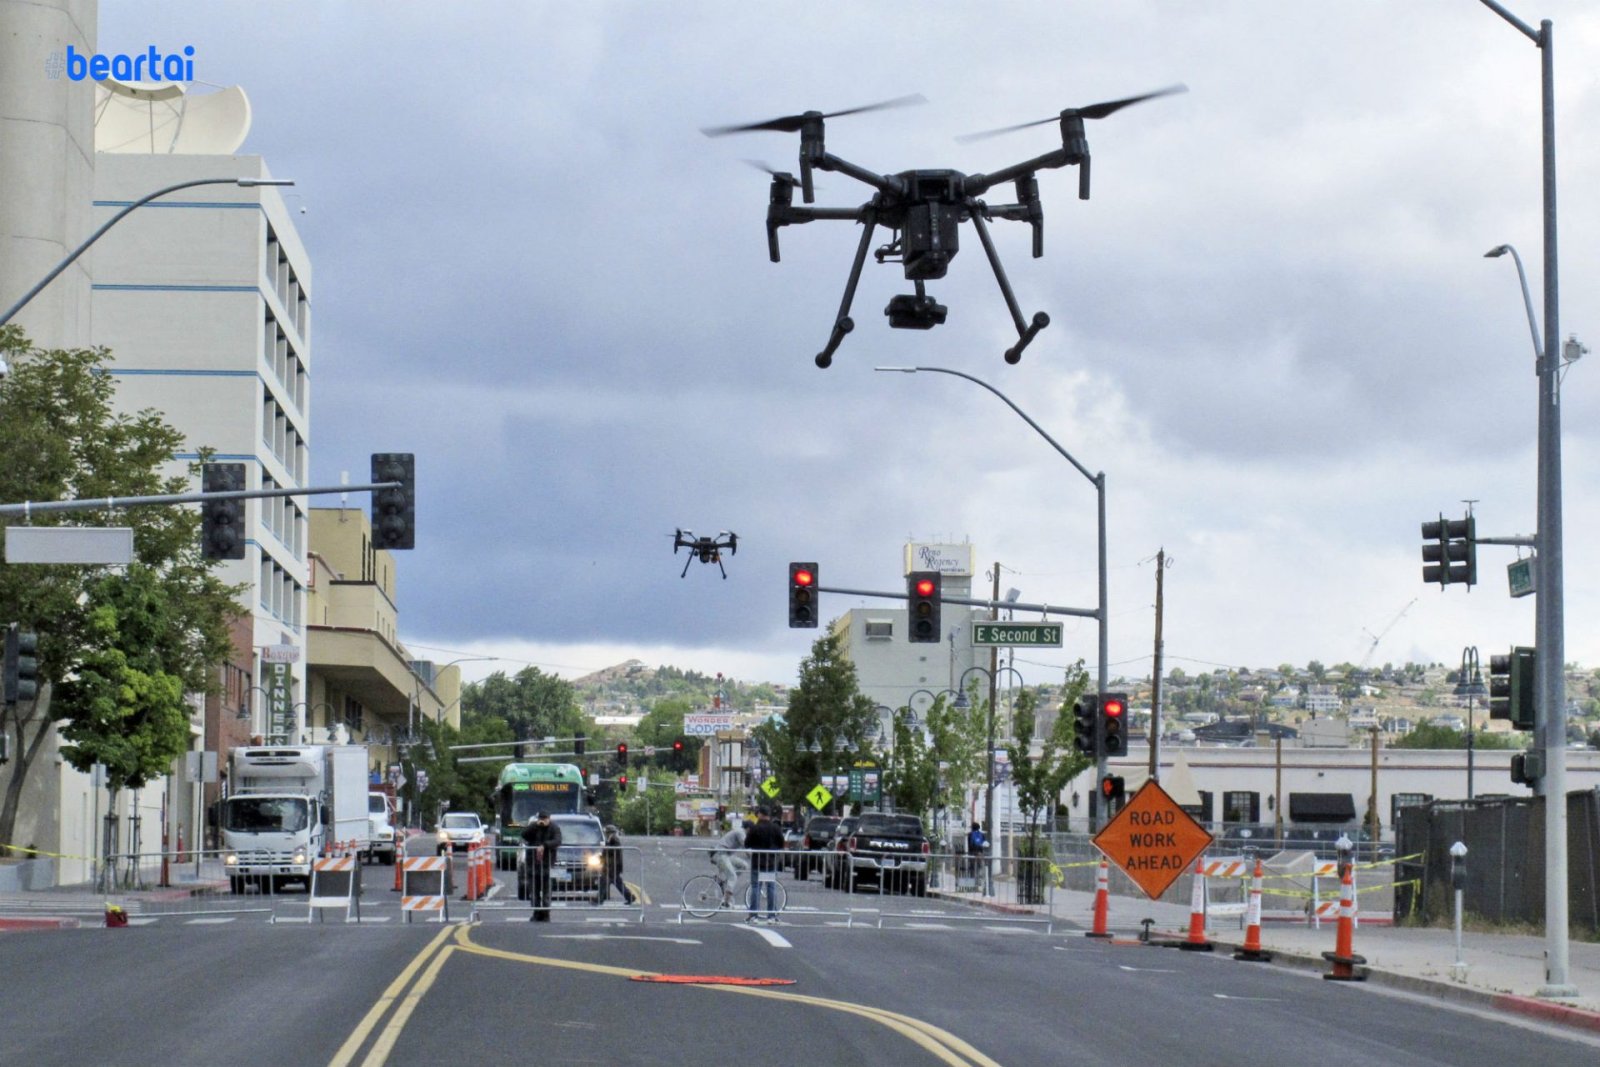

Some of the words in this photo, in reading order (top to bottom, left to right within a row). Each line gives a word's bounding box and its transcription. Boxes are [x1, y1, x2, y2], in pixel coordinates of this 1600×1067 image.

[919, 546, 941, 560] Reno
[977, 628, 986, 642] E
[990, 627, 1037, 642] Second
[1043, 628, 1058, 642] St
[687, 715, 730, 724] WONDER
[1129, 810, 1175, 826] ROAD
[1129, 832, 1177, 848] WORK
[1126, 855, 1183, 871] AHEAD
